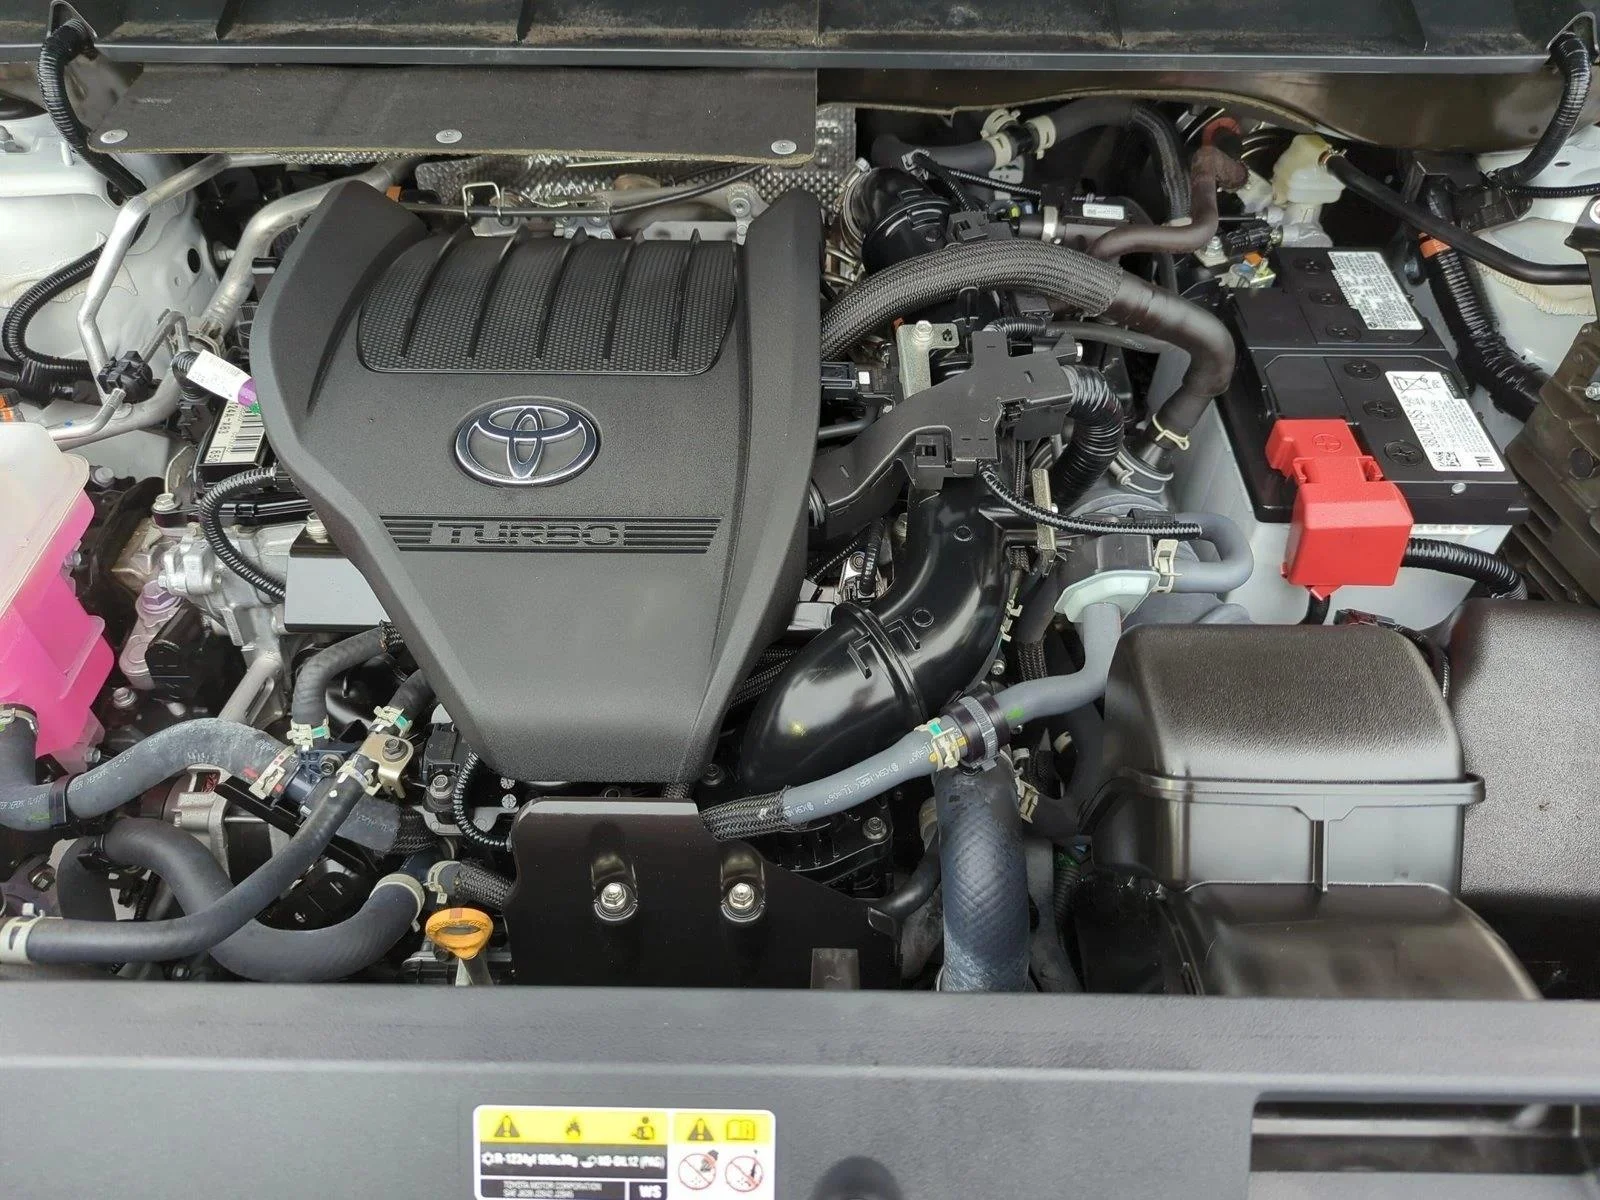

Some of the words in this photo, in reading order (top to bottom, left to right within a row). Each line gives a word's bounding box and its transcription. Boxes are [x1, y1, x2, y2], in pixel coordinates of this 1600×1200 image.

[1475, 456, 1495, 467] TM
[431, 520, 626, 545] TURBO
[639, 1185, 662, 1198] WS
